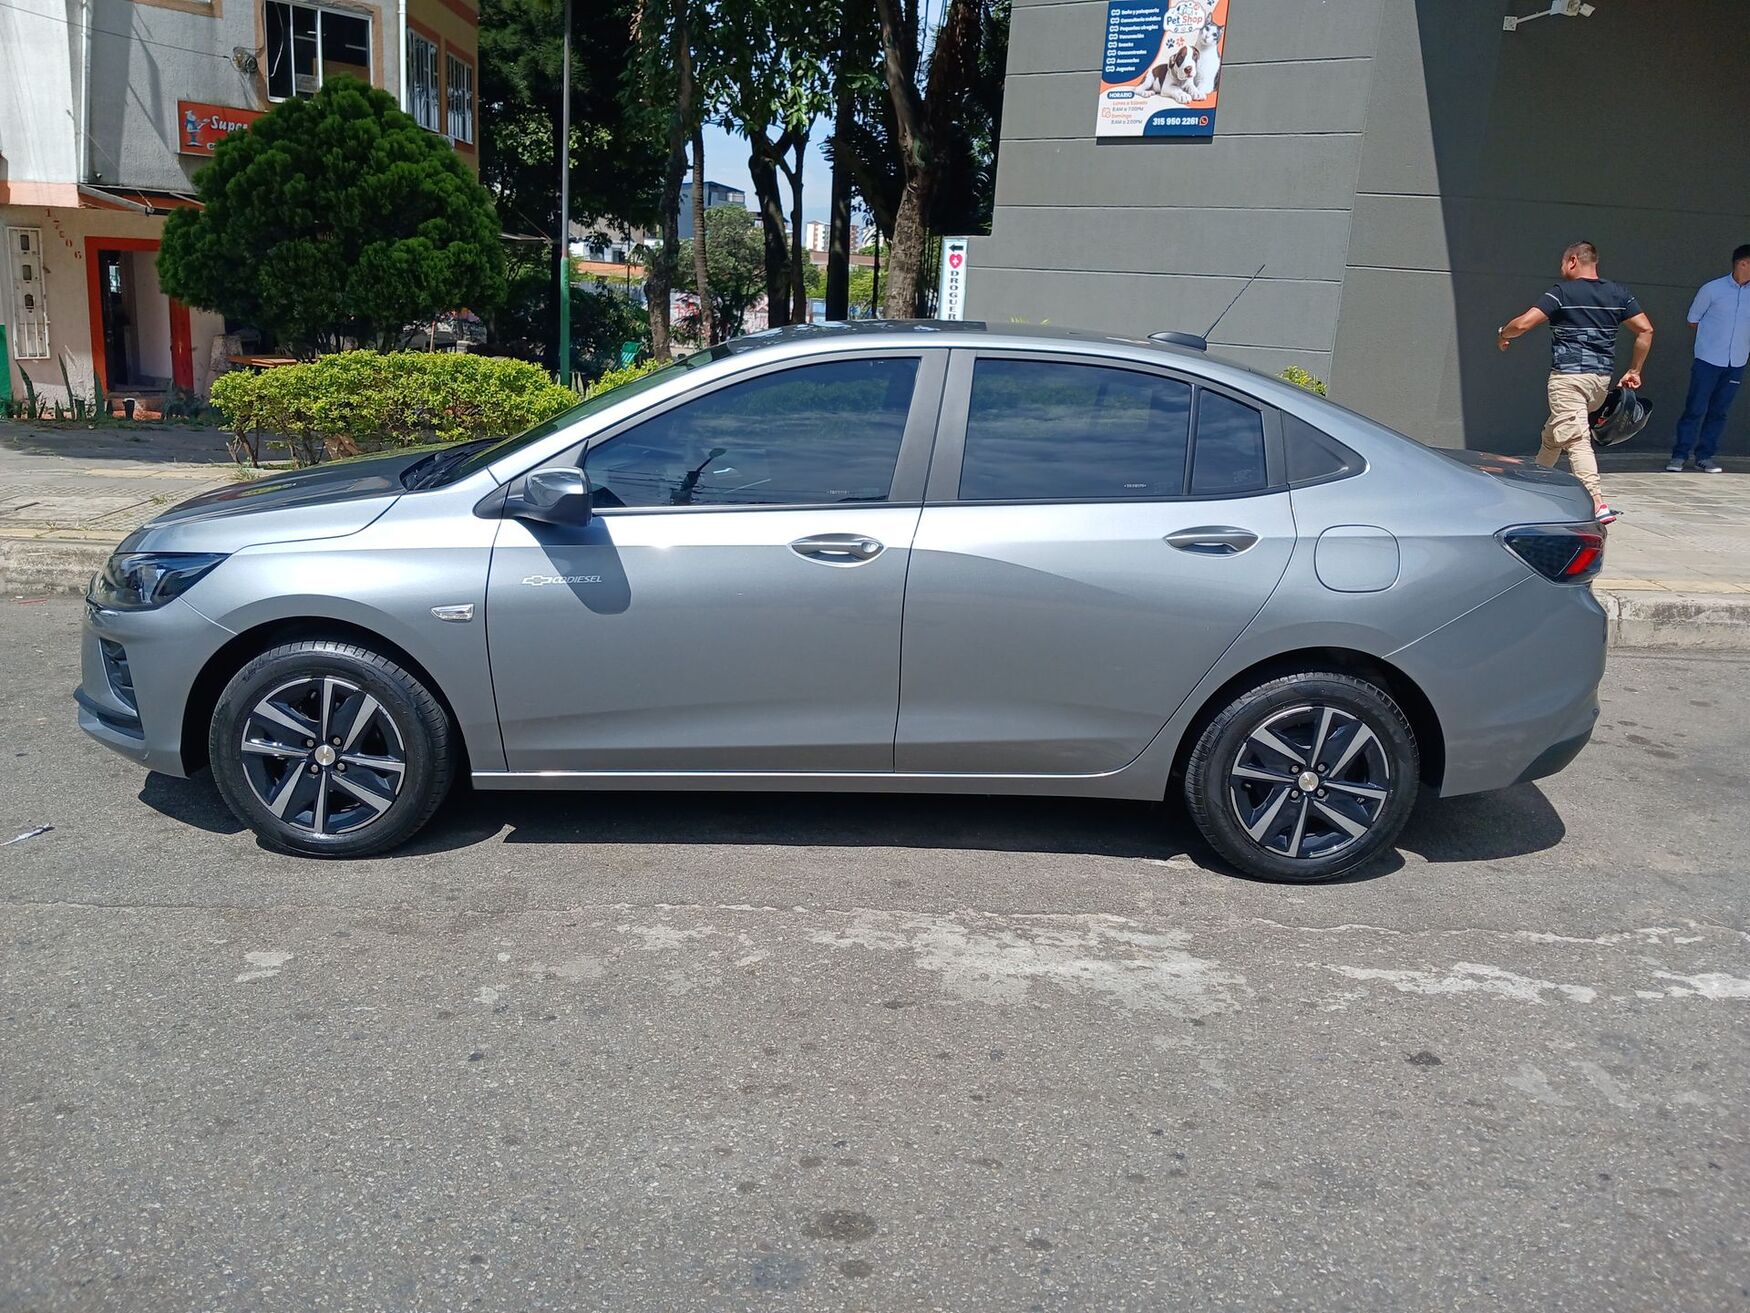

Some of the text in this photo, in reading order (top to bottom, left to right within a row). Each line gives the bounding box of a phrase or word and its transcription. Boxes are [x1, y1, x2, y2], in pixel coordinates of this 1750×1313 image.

[1166, 14, 1203, 25] Pet Shop
[1152, 117, 1165, 126] 315
[1165, 117, 1180, 126] 950
